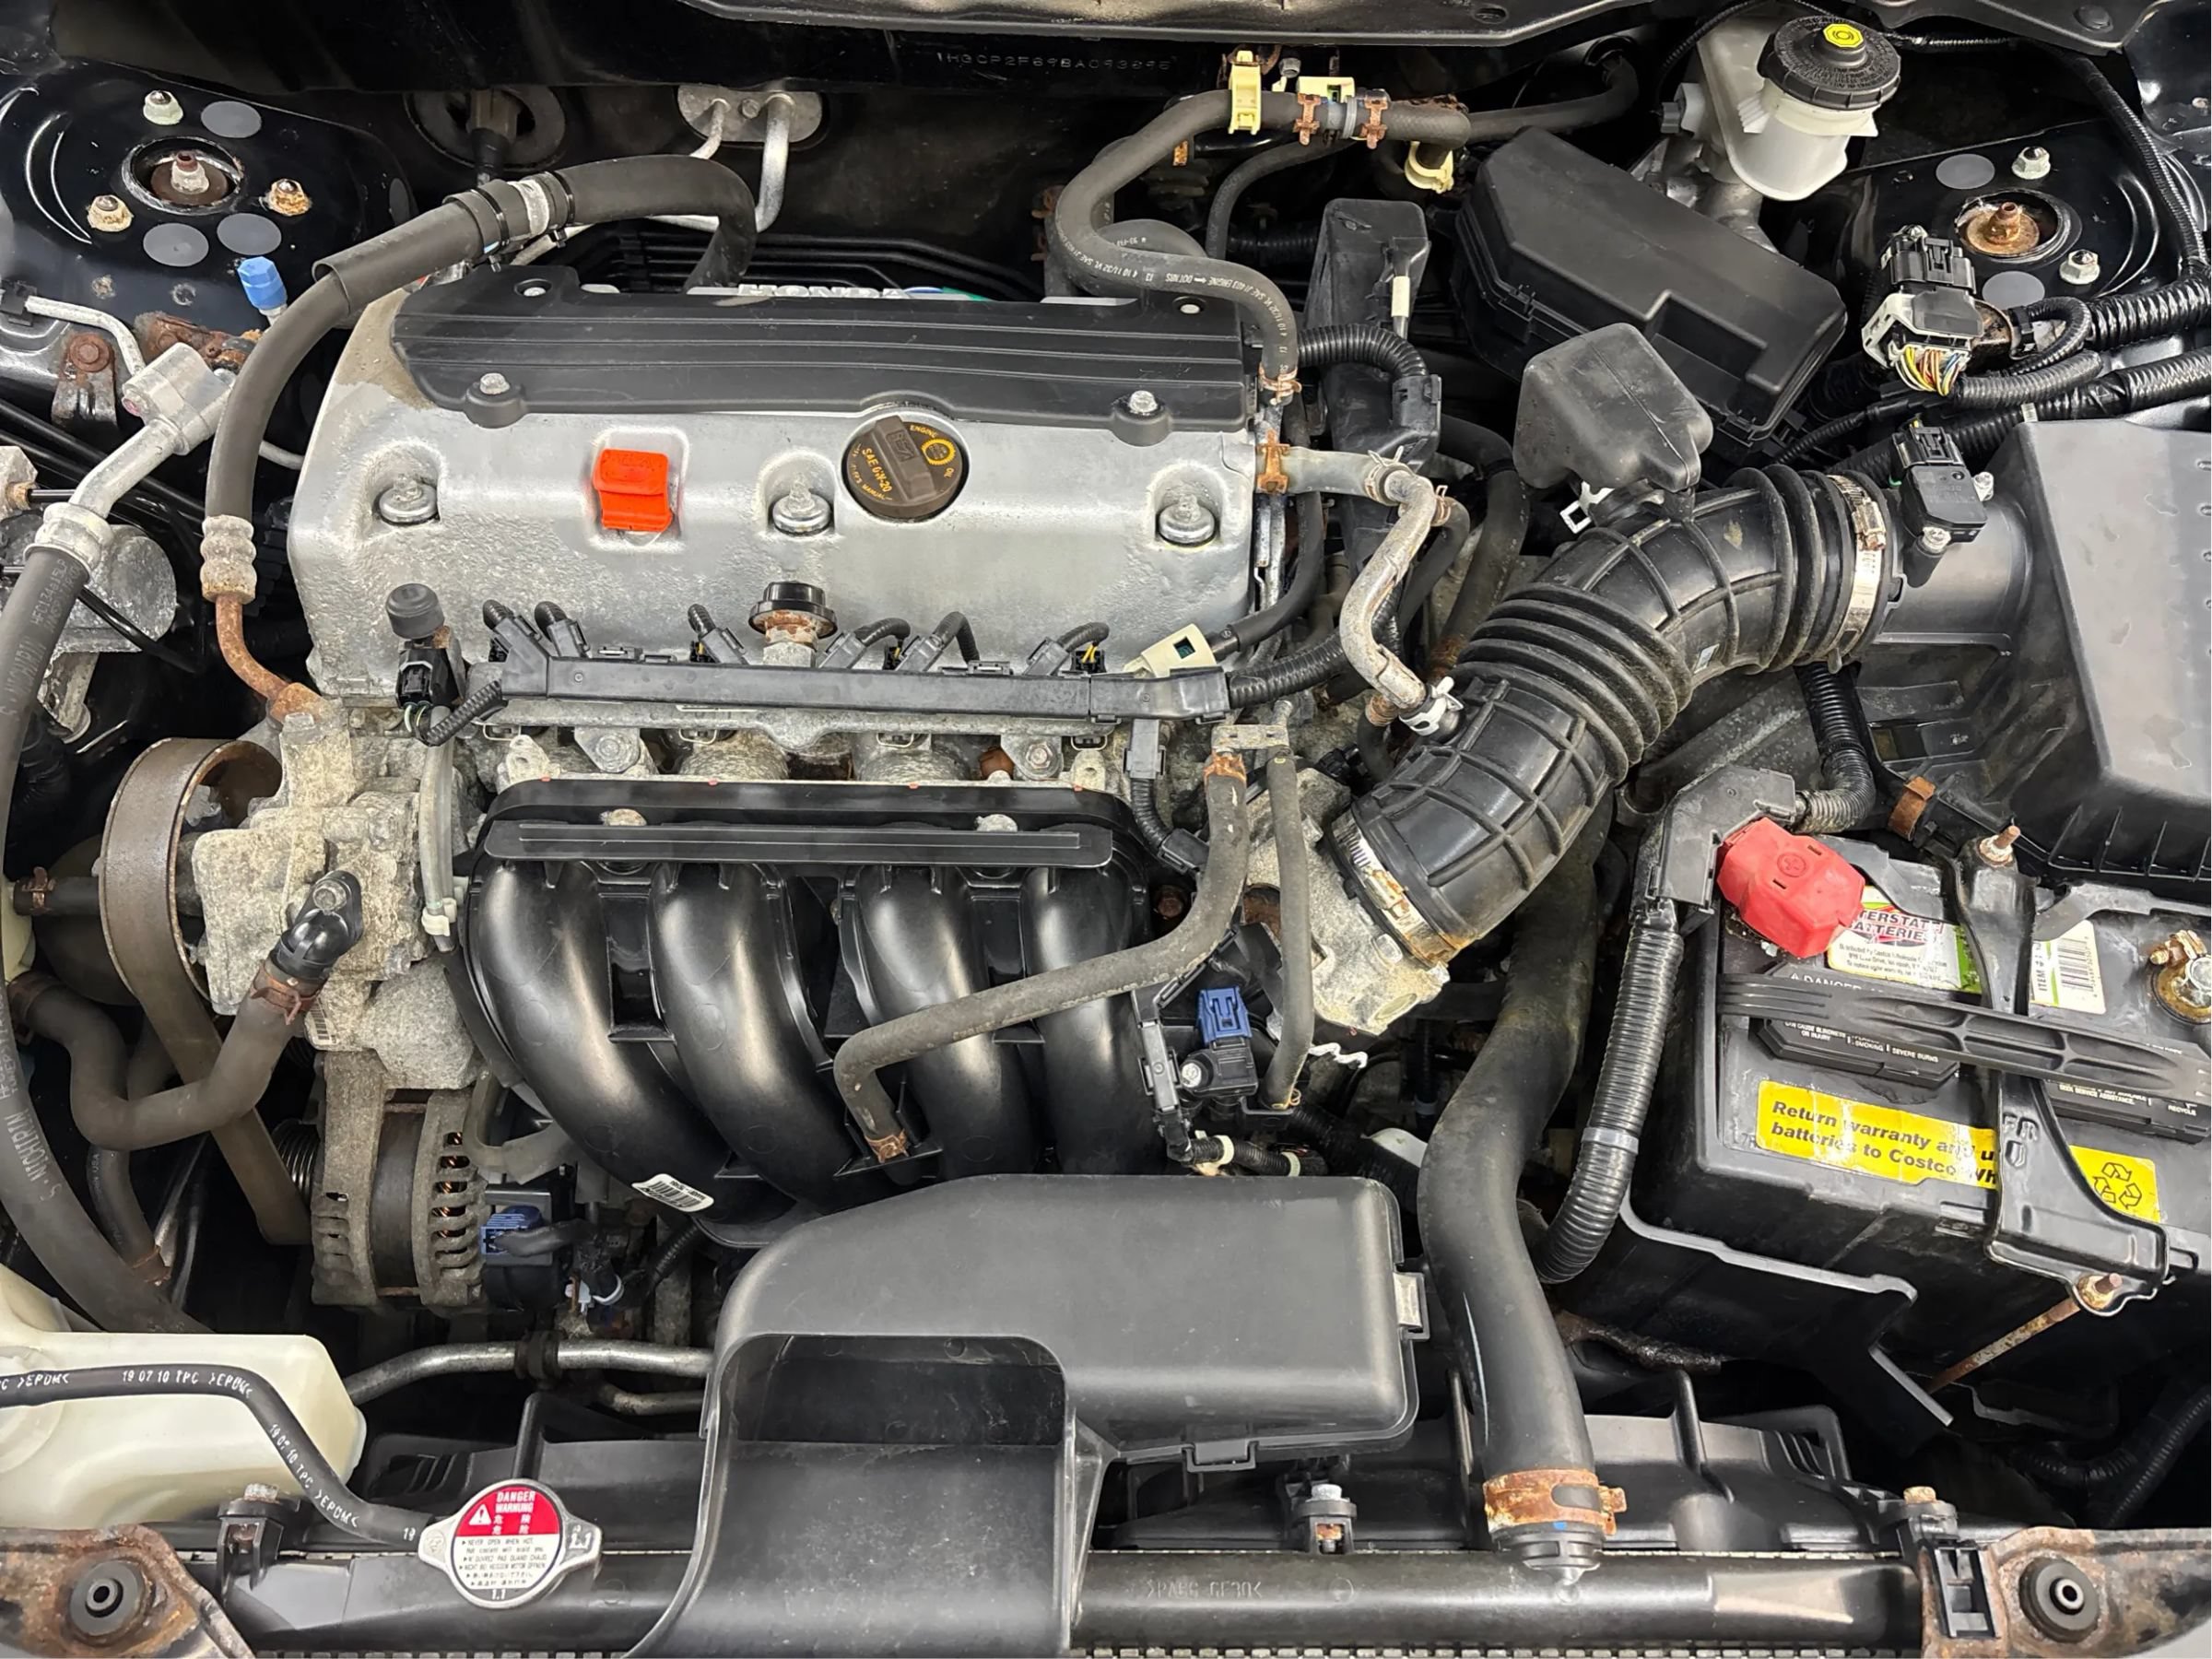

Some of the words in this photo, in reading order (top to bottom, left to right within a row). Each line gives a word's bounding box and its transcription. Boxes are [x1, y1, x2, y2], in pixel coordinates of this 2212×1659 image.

[910, 425, 938, 438] ENGINE
[862, 448, 879, 467] SAE
[1772, 1100, 1837, 1127] Return
[1844, 1119, 1933, 1150] warranty
[1771, 1122, 1858, 1153] batteries
[1863, 1142, 1883, 1159] to
[1889, 1148, 1957, 1176] Costco
[122, 1370, 134, 1382] 19
[138, 1370, 152, 1382] 07
[157, 1370, 170, 1382] 10
[175, 1370, 199, 1384] TPC
[269, 1423, 281, 1438] 19
[287, 1449, 299, 1465] 10
[296, 1464, 313, 1488] TPC
[497, 1490, 535, 1502] DANGER
[495, 1501, 534, 1513] WARNUNG
[403, 1527, 416, 1541] 19
[492, 1589, 506, 1600] 1.1
